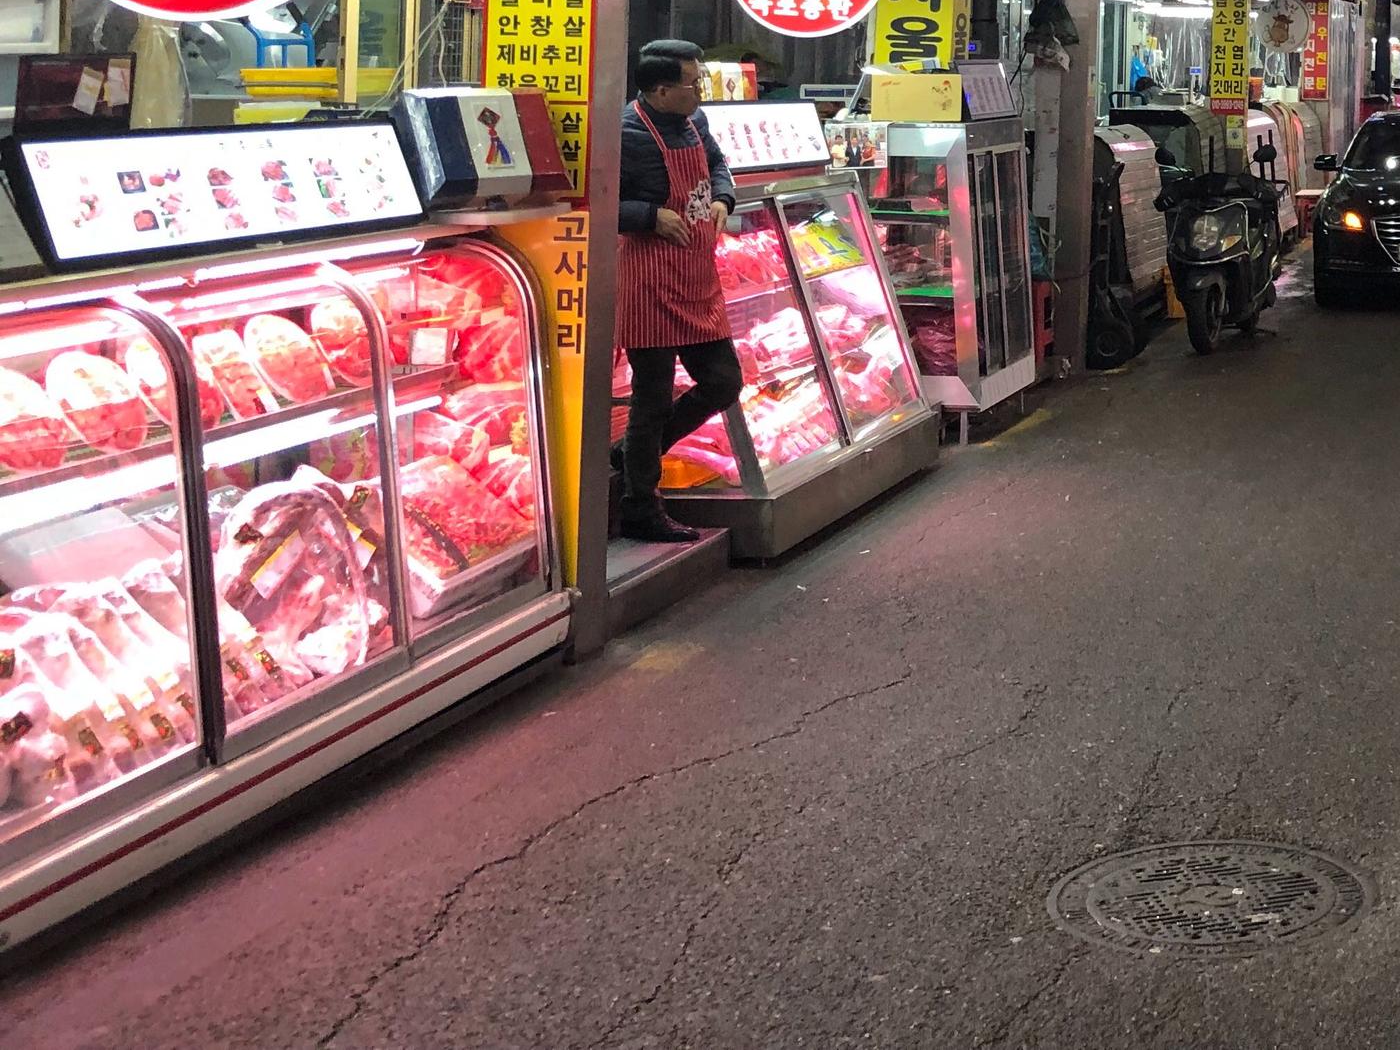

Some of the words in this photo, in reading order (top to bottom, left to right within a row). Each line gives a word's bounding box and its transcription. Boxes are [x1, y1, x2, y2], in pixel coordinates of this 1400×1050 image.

[497, 14, 587, 38] 안창살
[496, 42, 584, 67] 제비추리
[552, 215, 588, 355] 고사머리
